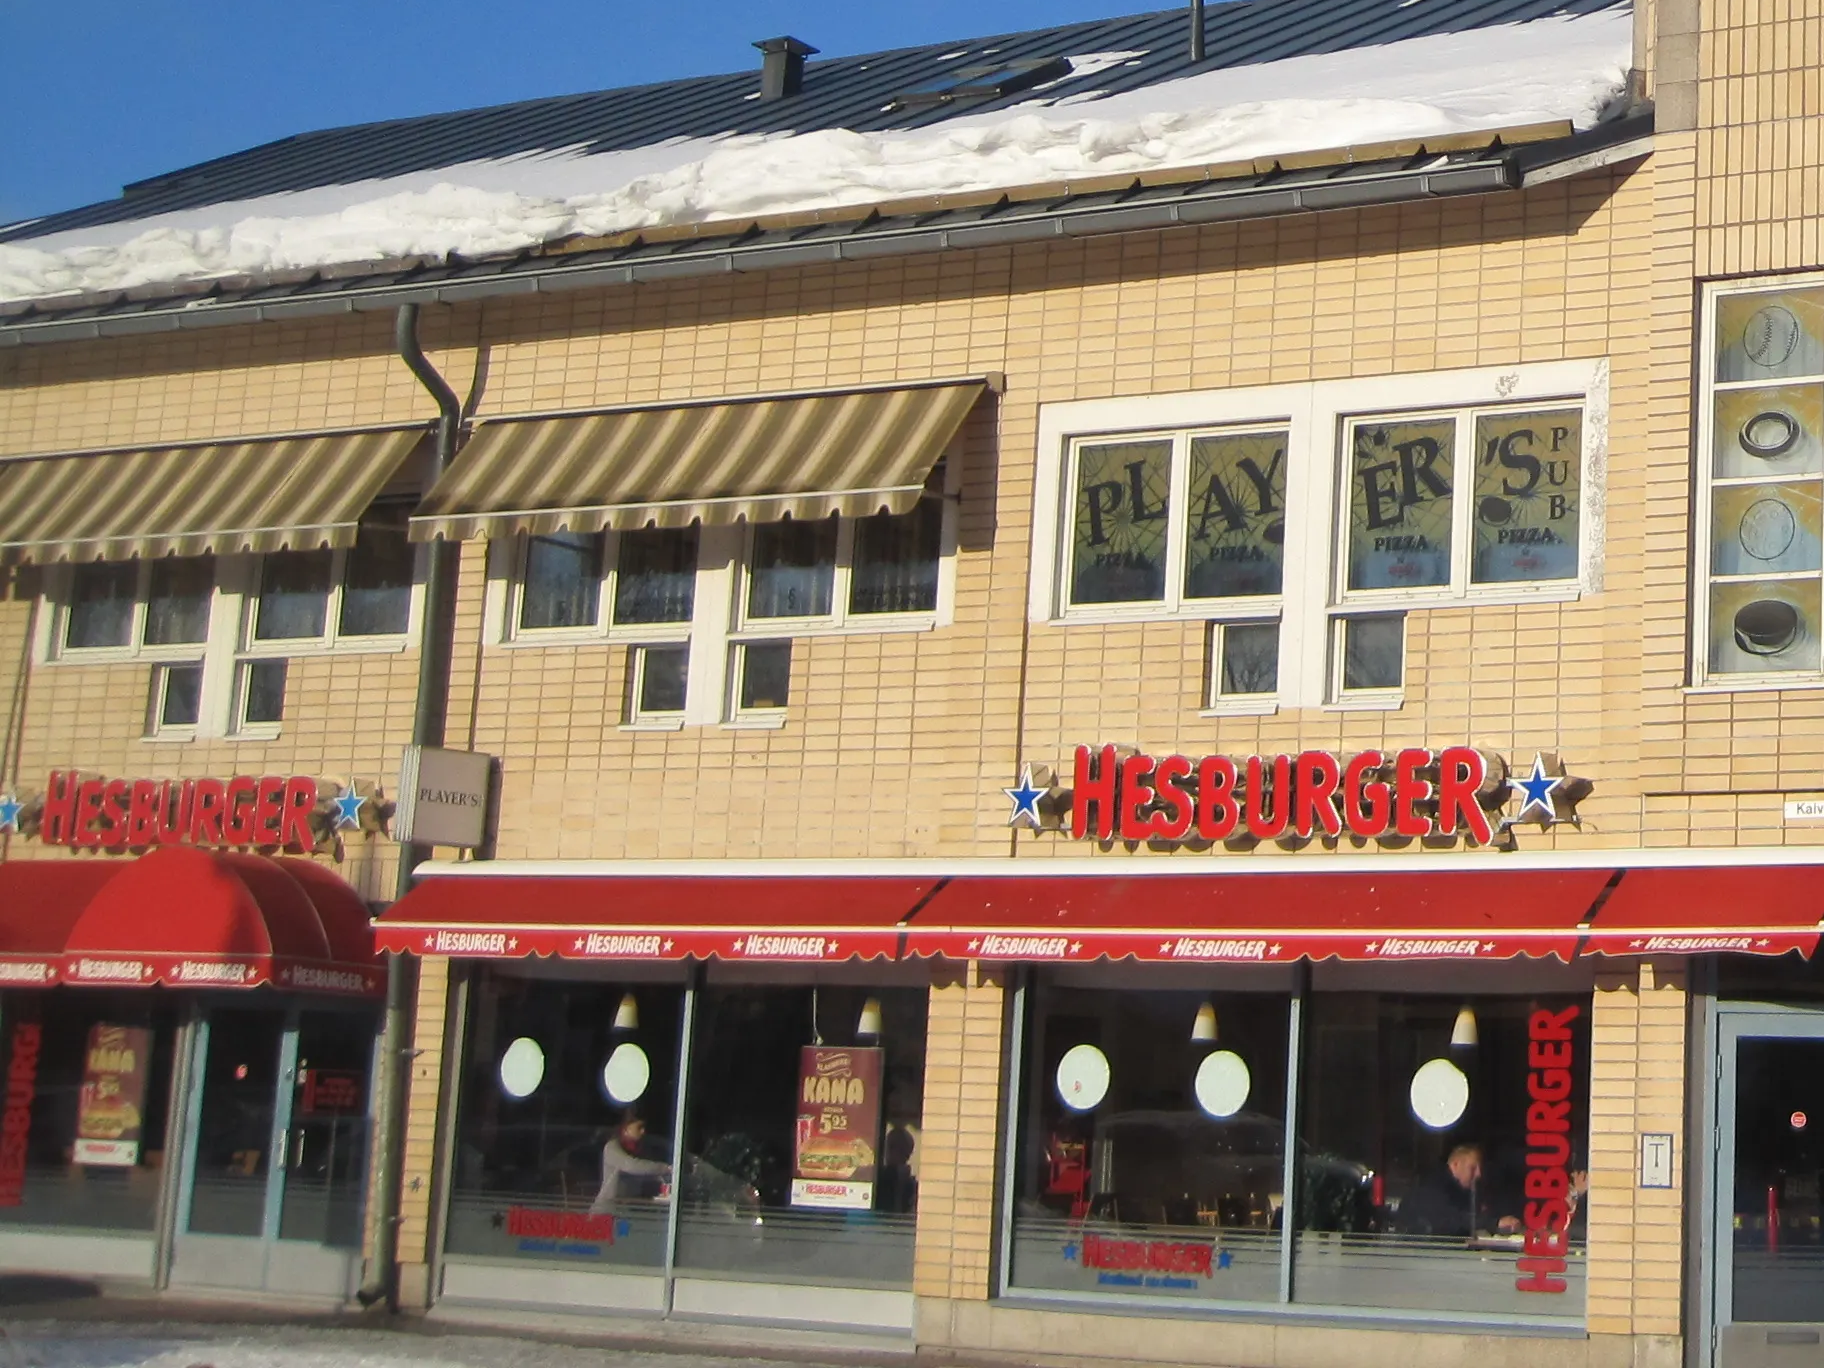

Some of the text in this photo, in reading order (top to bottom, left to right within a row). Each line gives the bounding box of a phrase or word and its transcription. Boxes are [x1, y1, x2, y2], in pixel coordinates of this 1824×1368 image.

[1374, 535, 1429, 552] PIZZA
[420, 788, 478, 808] PLAYER'S
[1071, 743, 1494, 846] HESBURGER
[41, 769, 320, 851] HESBURGER
[436, 931, 506, 954] HESBURGER
[585, 933, 661, 956] HESBURGER
[744, 934, 825, 958] HESBURGER
[980, 934, 1068, 959] HESBURGER
[1173, 936, 1267, 960] HESBURGER
[1379, 938, 1480, 957] HESBURGER
[1644, 935, 1753, 951] HESBURGER
[77, 958, 144, 982] HESBURGER
[181, 960, 247, 984] HESBURGER
[293, 964, 365, 992] HESBURGER
[803, 1076, 865, 1105] KANA
[1515, 1005, 1581, 1293] HESBURGER
[1082, 1234, 1213, 1280] HESBURGER
